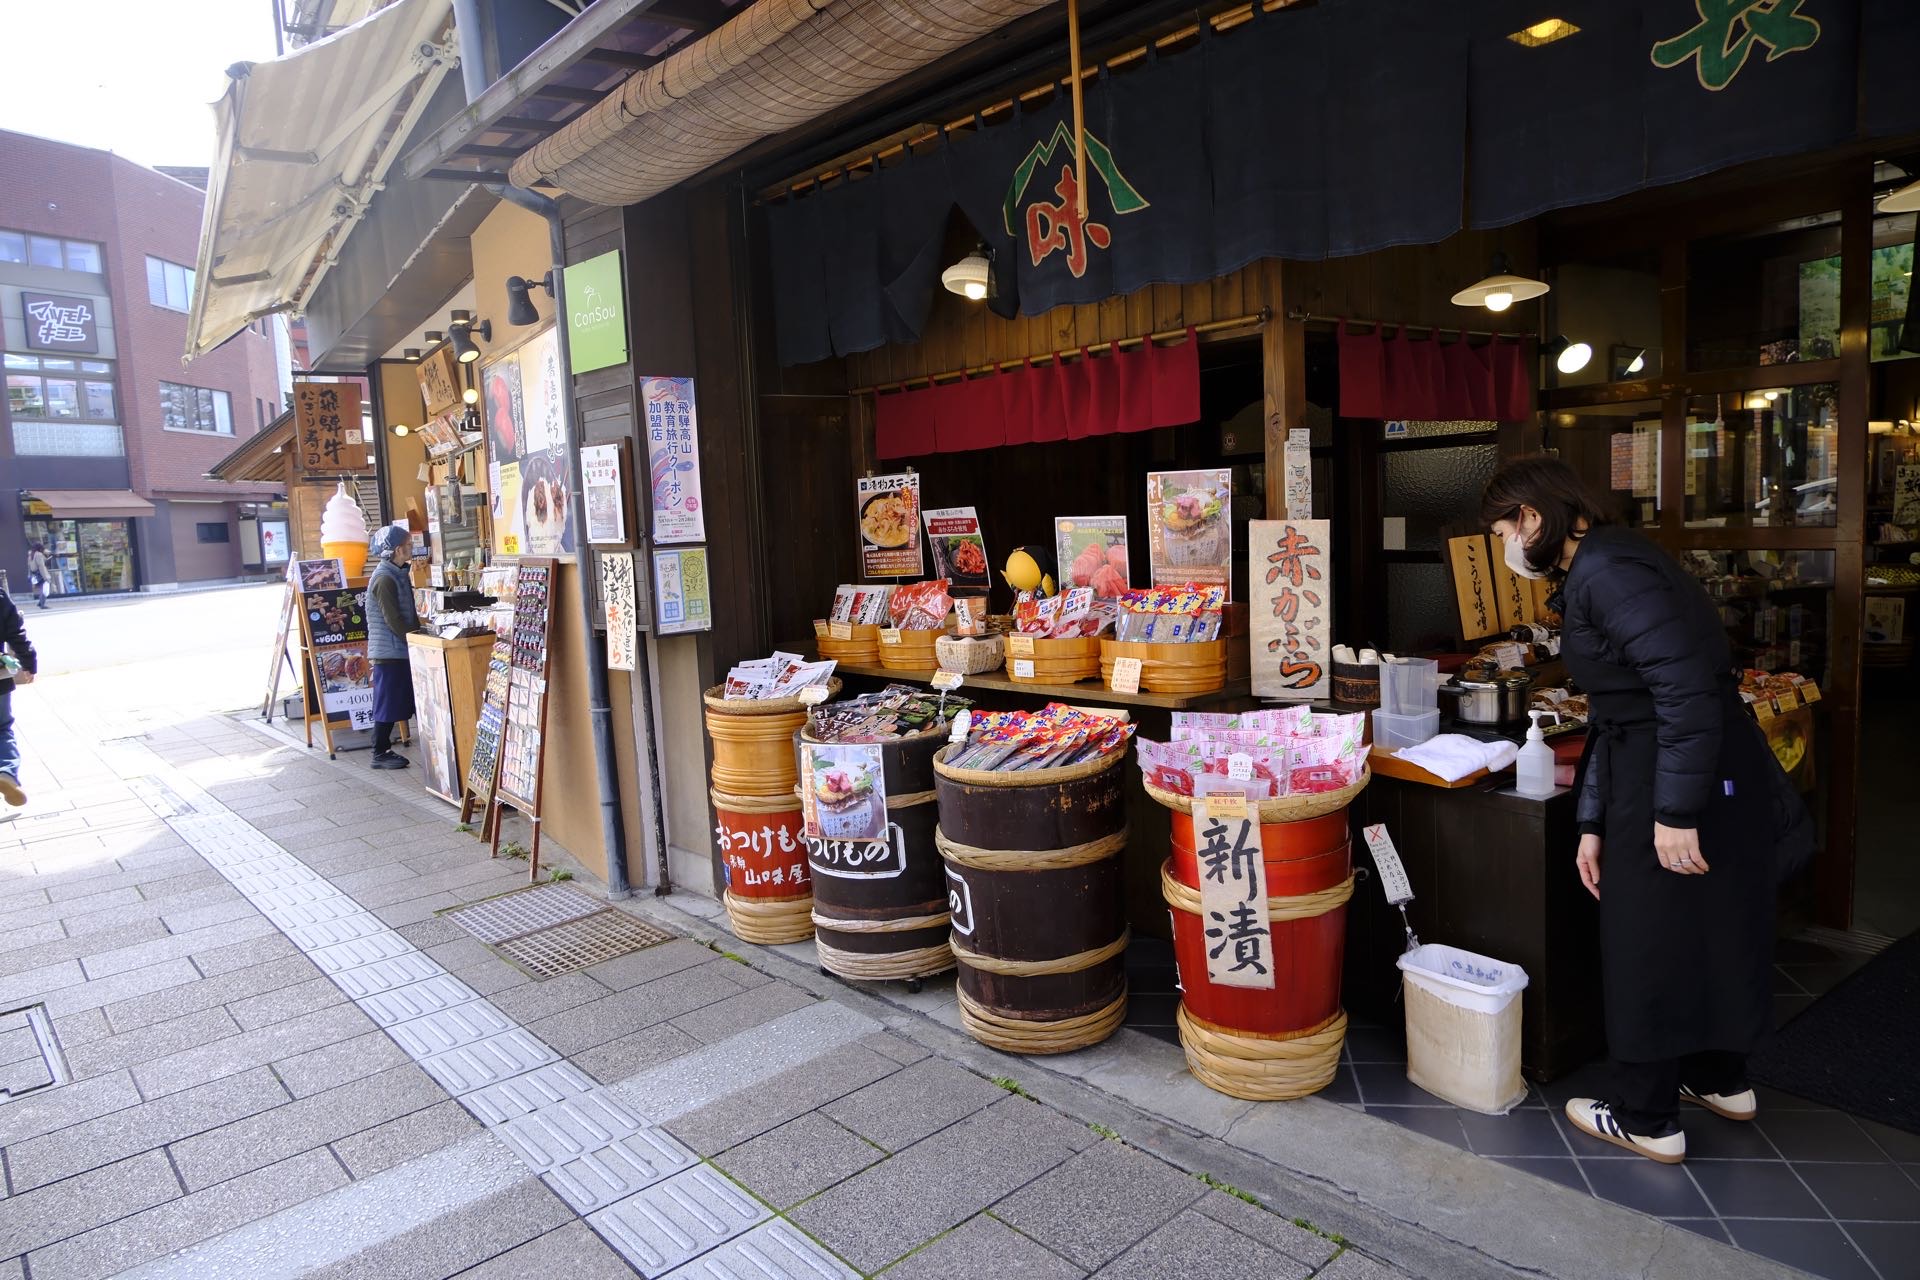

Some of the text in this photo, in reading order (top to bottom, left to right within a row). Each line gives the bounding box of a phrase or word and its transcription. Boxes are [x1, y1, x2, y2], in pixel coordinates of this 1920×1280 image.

[28, 301, 91, 326] マツモト
[39, 319, 86, 344] キヨシ
[574, 304, 616, 328] ConSou
[300, 391, 321, 465] にぎり寿司
[319, 389, 345, 464] 飛騨牛
[649, 401, 663, 441] 加盟店
[678, 401, 692, 454] 飛騨高山
[664, 401, 682, 507] 教育旅行クーポン
[1265, 525, 1323, 690] 赤かぶら
[745, 863, 811, 885] 山味屋
[806, 838, 890, 866] つけもの
[1198, 818, 1271, 974] 新漬
